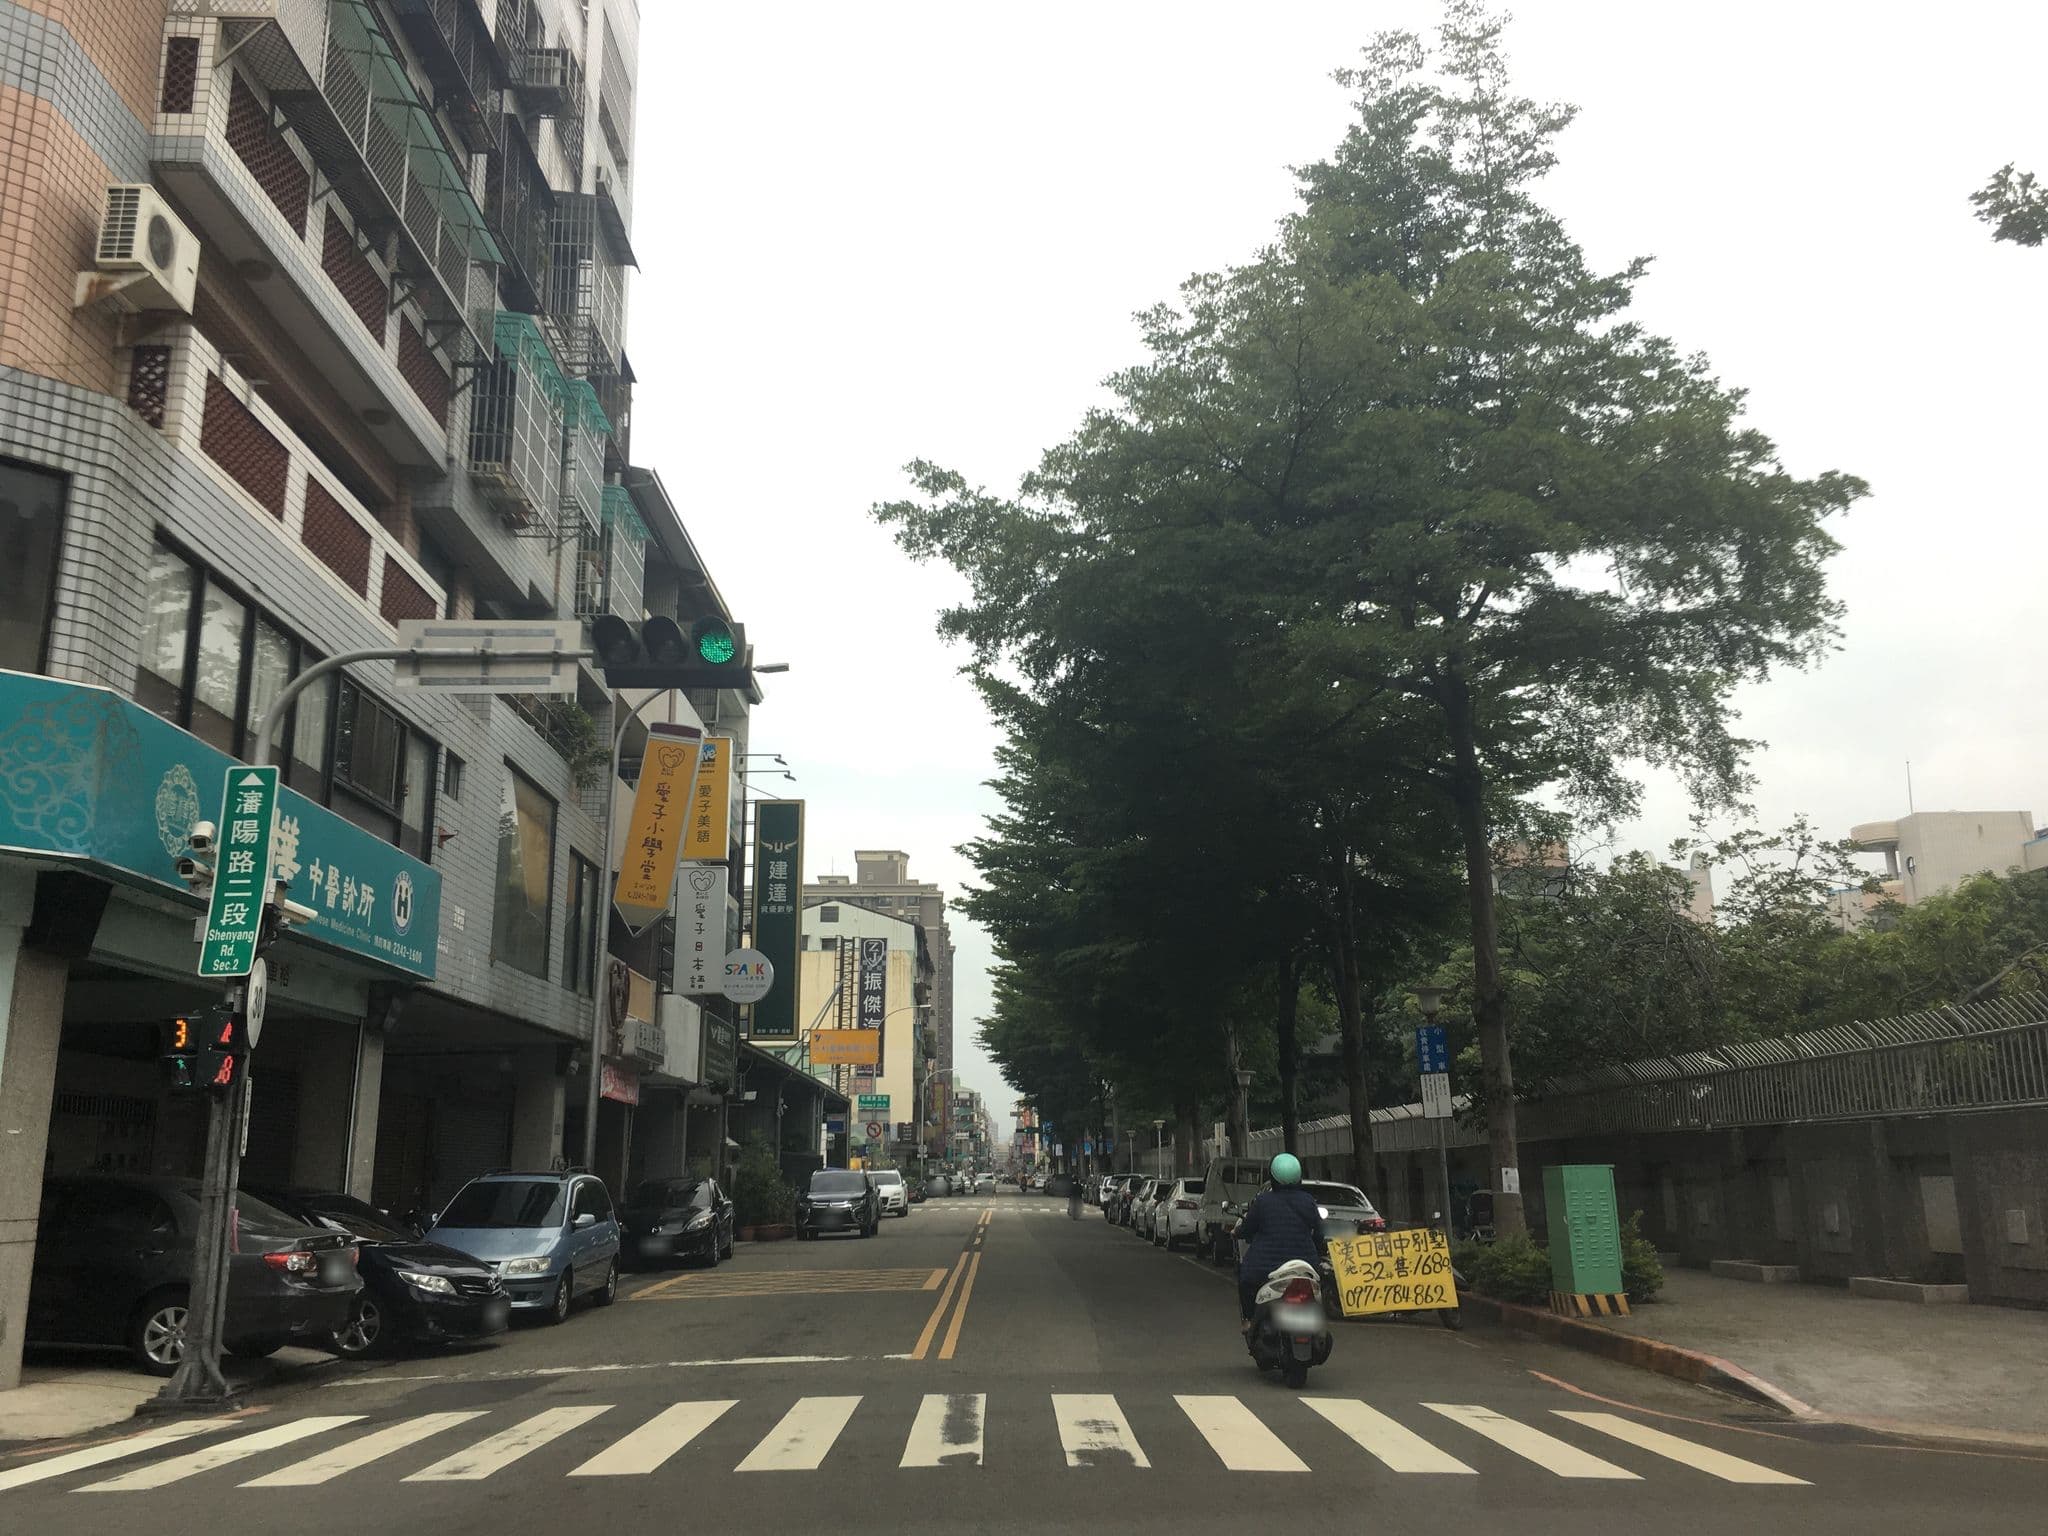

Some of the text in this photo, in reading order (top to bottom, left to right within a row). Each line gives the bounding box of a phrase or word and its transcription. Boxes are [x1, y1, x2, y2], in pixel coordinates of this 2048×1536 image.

[640, 782, 671, 880] 愛子小學堂
[697, 785, 712, 843] 愛子美語
[220, 790, 263, 926] 瀋陽路二段
[768, 861, 788, 902] 建達
[309, 857, 375, 928] 中醫診所
[208, 929, 255, 944] Shenyang
[220, 944, 235, 957] Rd.
[690, 902, 706, 989] 愛子日本語
[725, 963, 765, 976] SPARK
[1334, 1230, 1446, 1265] 漢口國中別墅
